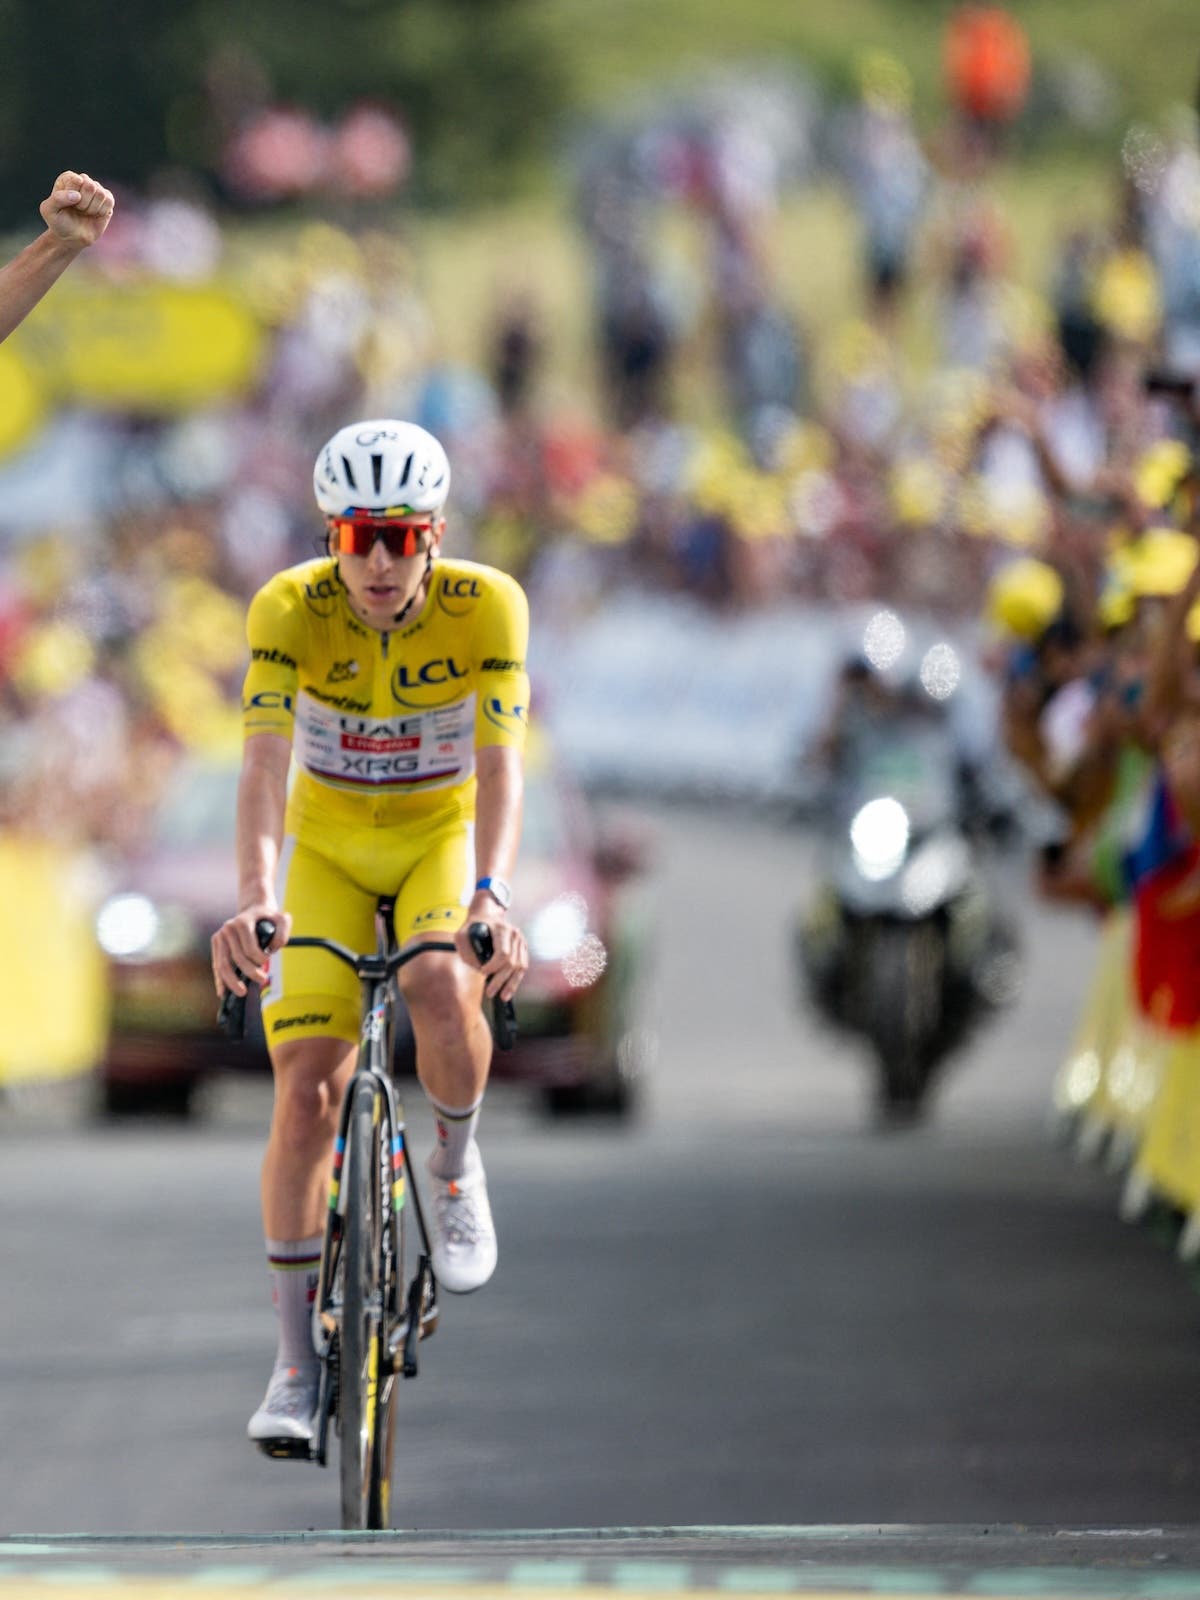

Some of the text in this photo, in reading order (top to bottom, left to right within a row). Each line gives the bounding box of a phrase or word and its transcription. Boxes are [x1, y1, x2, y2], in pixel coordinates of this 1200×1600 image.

[442, 577, 481, 598] LCL
[400, 657, 469, 688] LCL
[340, 717, 421, 737] UAE
[342, 755, 418, 775] XRG
